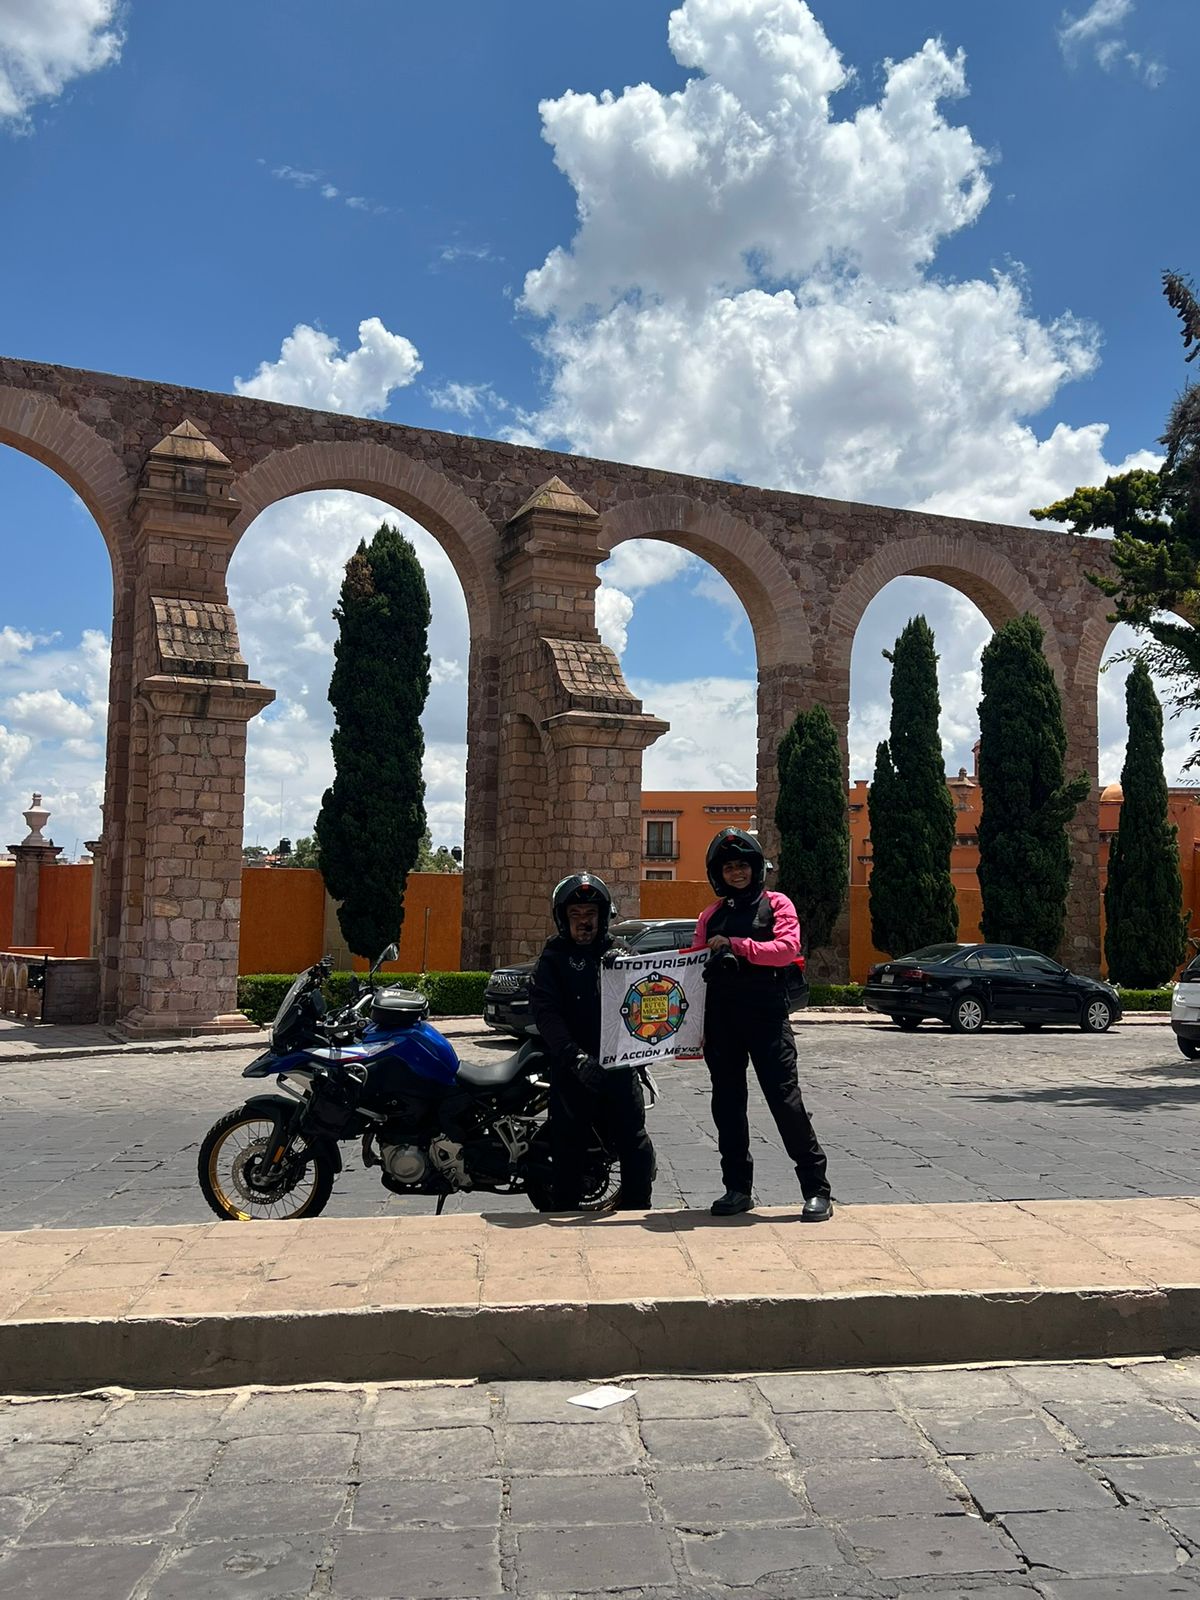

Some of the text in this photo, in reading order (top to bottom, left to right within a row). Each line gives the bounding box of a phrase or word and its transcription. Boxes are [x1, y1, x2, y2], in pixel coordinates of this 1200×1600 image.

[602, 953, 708, 970] MOTOTURISMO
[602, 1055, 617, 1065] EN
[620, 1047, 661, 1062] ACCIÓN
